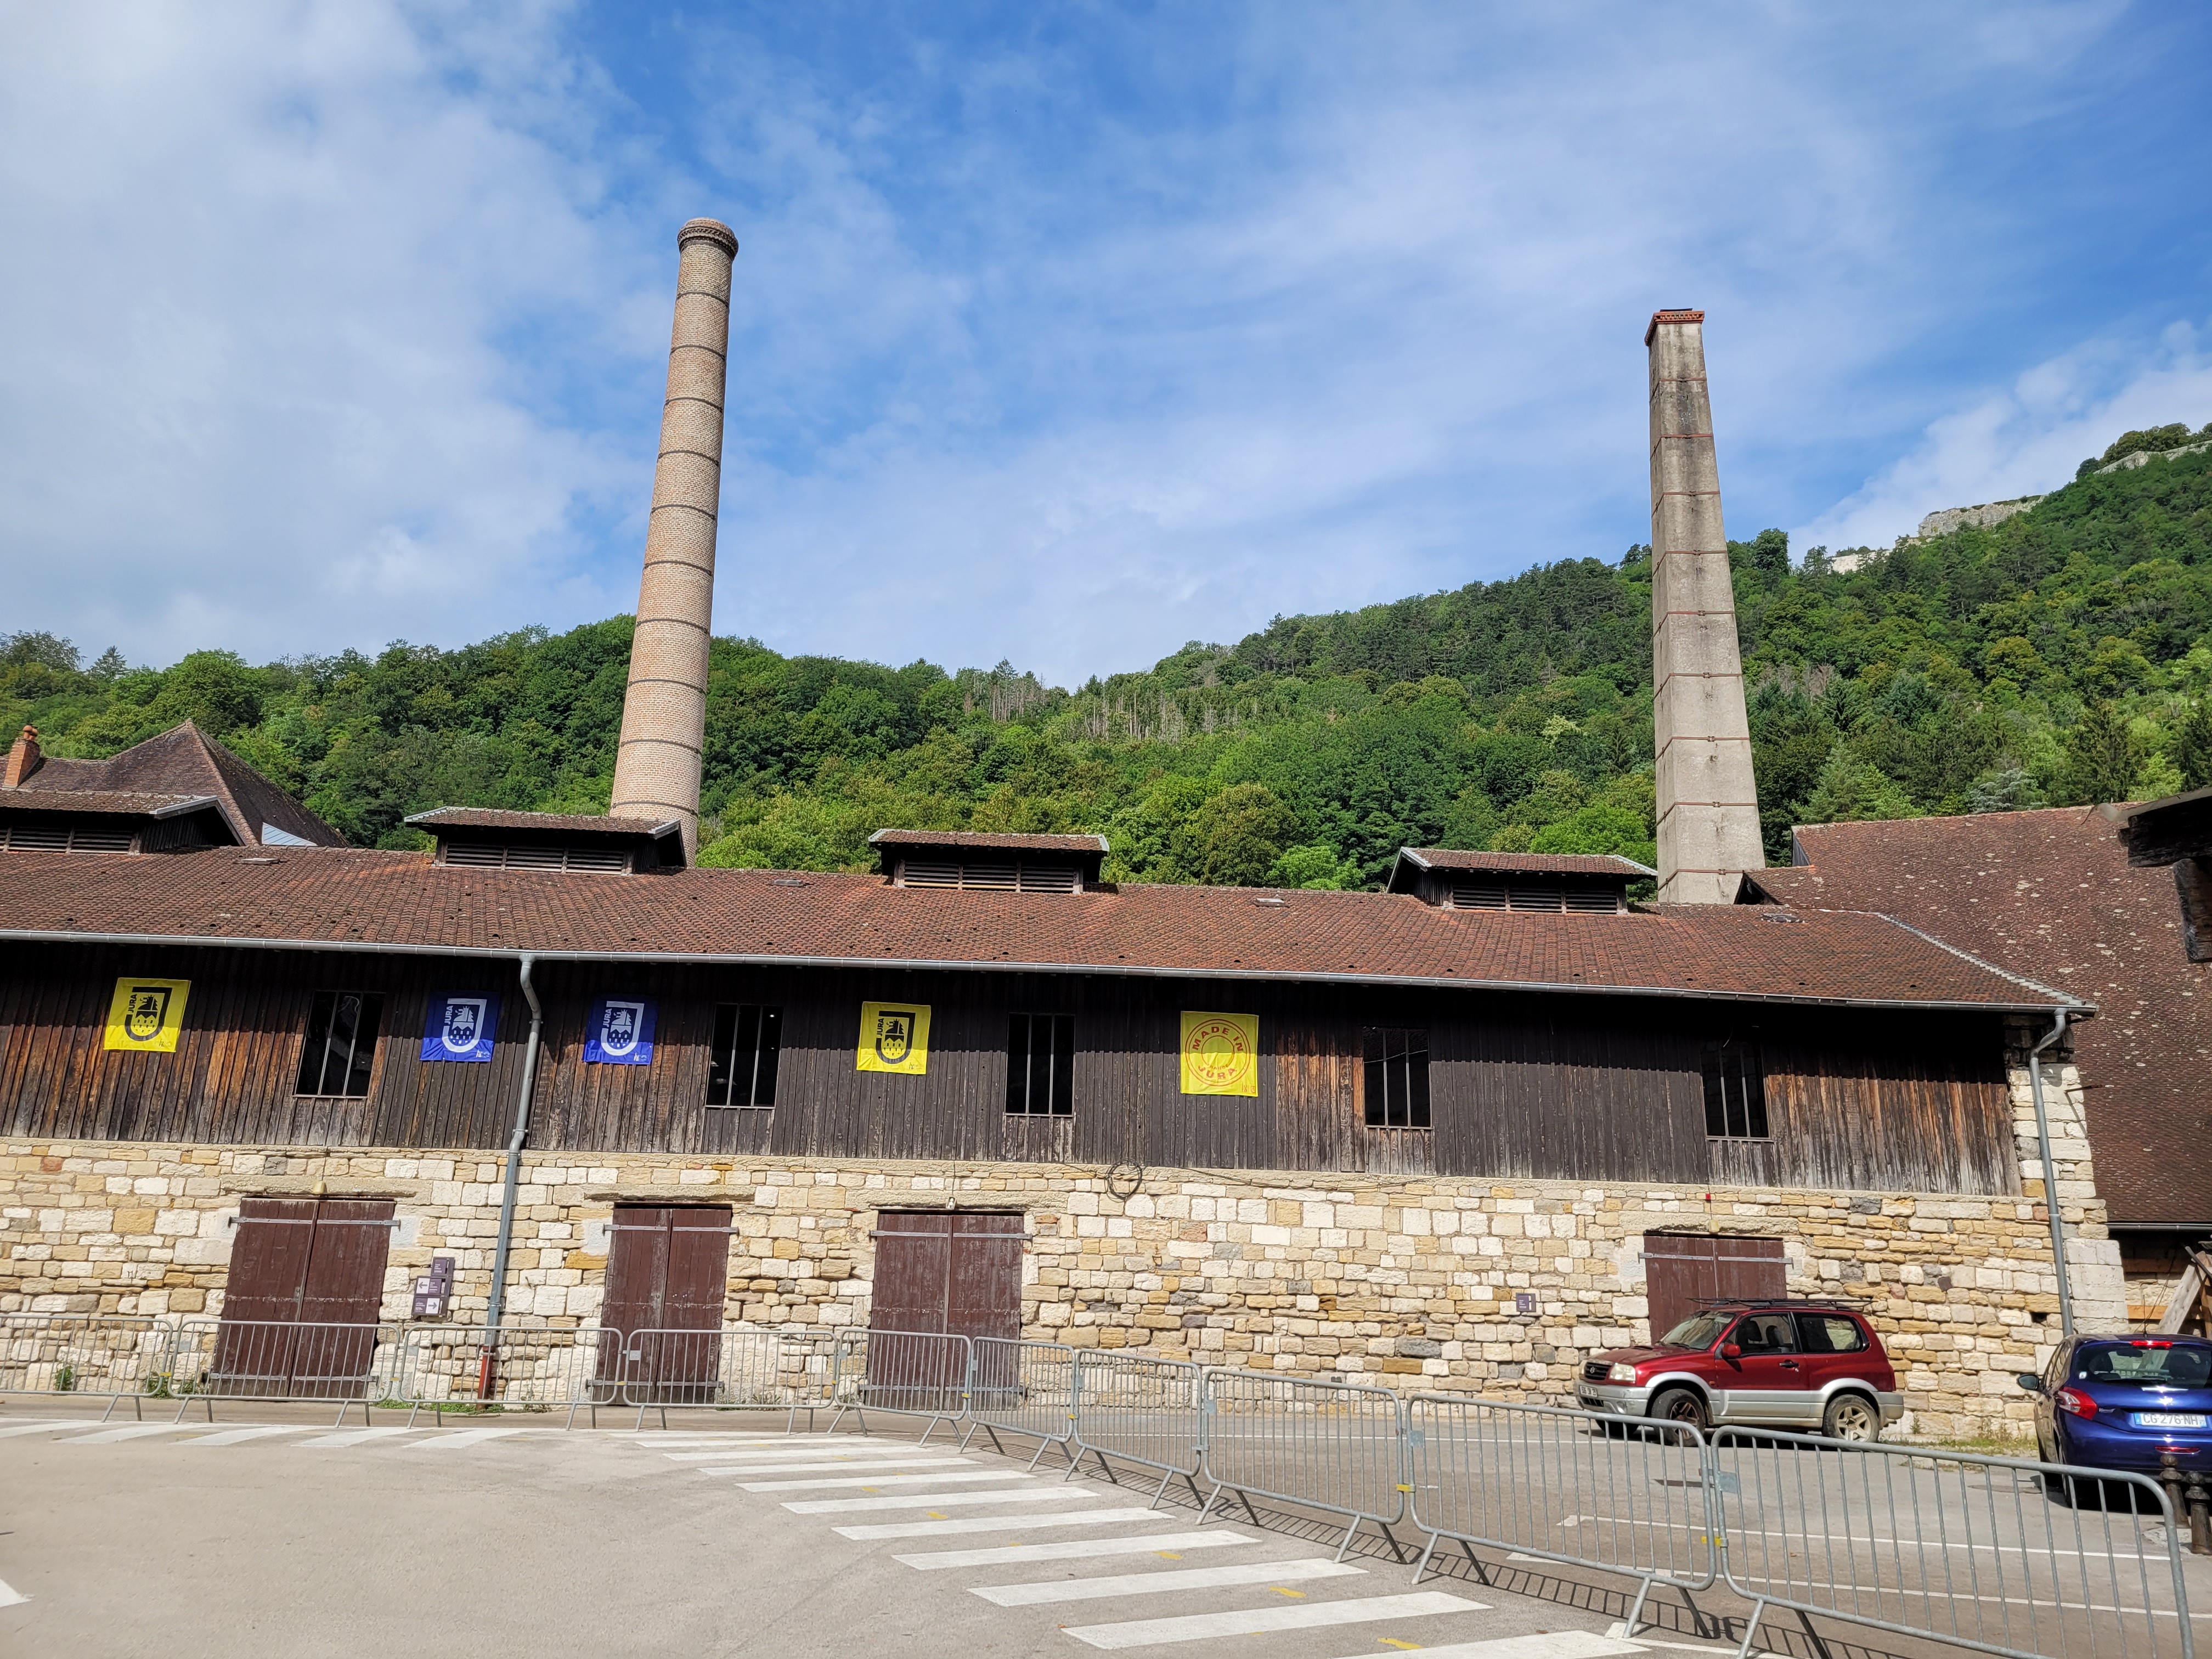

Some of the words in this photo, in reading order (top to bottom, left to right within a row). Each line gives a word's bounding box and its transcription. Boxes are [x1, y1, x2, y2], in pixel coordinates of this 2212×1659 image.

[128, 994, 137, 1013] JURA
[444, 1005, 453, 1025] JURA
[602, 1008, 612, 1028] JURA
[1192, 1026, 1230, 1051] MADE
[1233, 1036, 1244, 1052] IN
[1198, 1065, 1237, 1080] JURA
[2143, 1414, 2199, 1425] CG-276-NH
